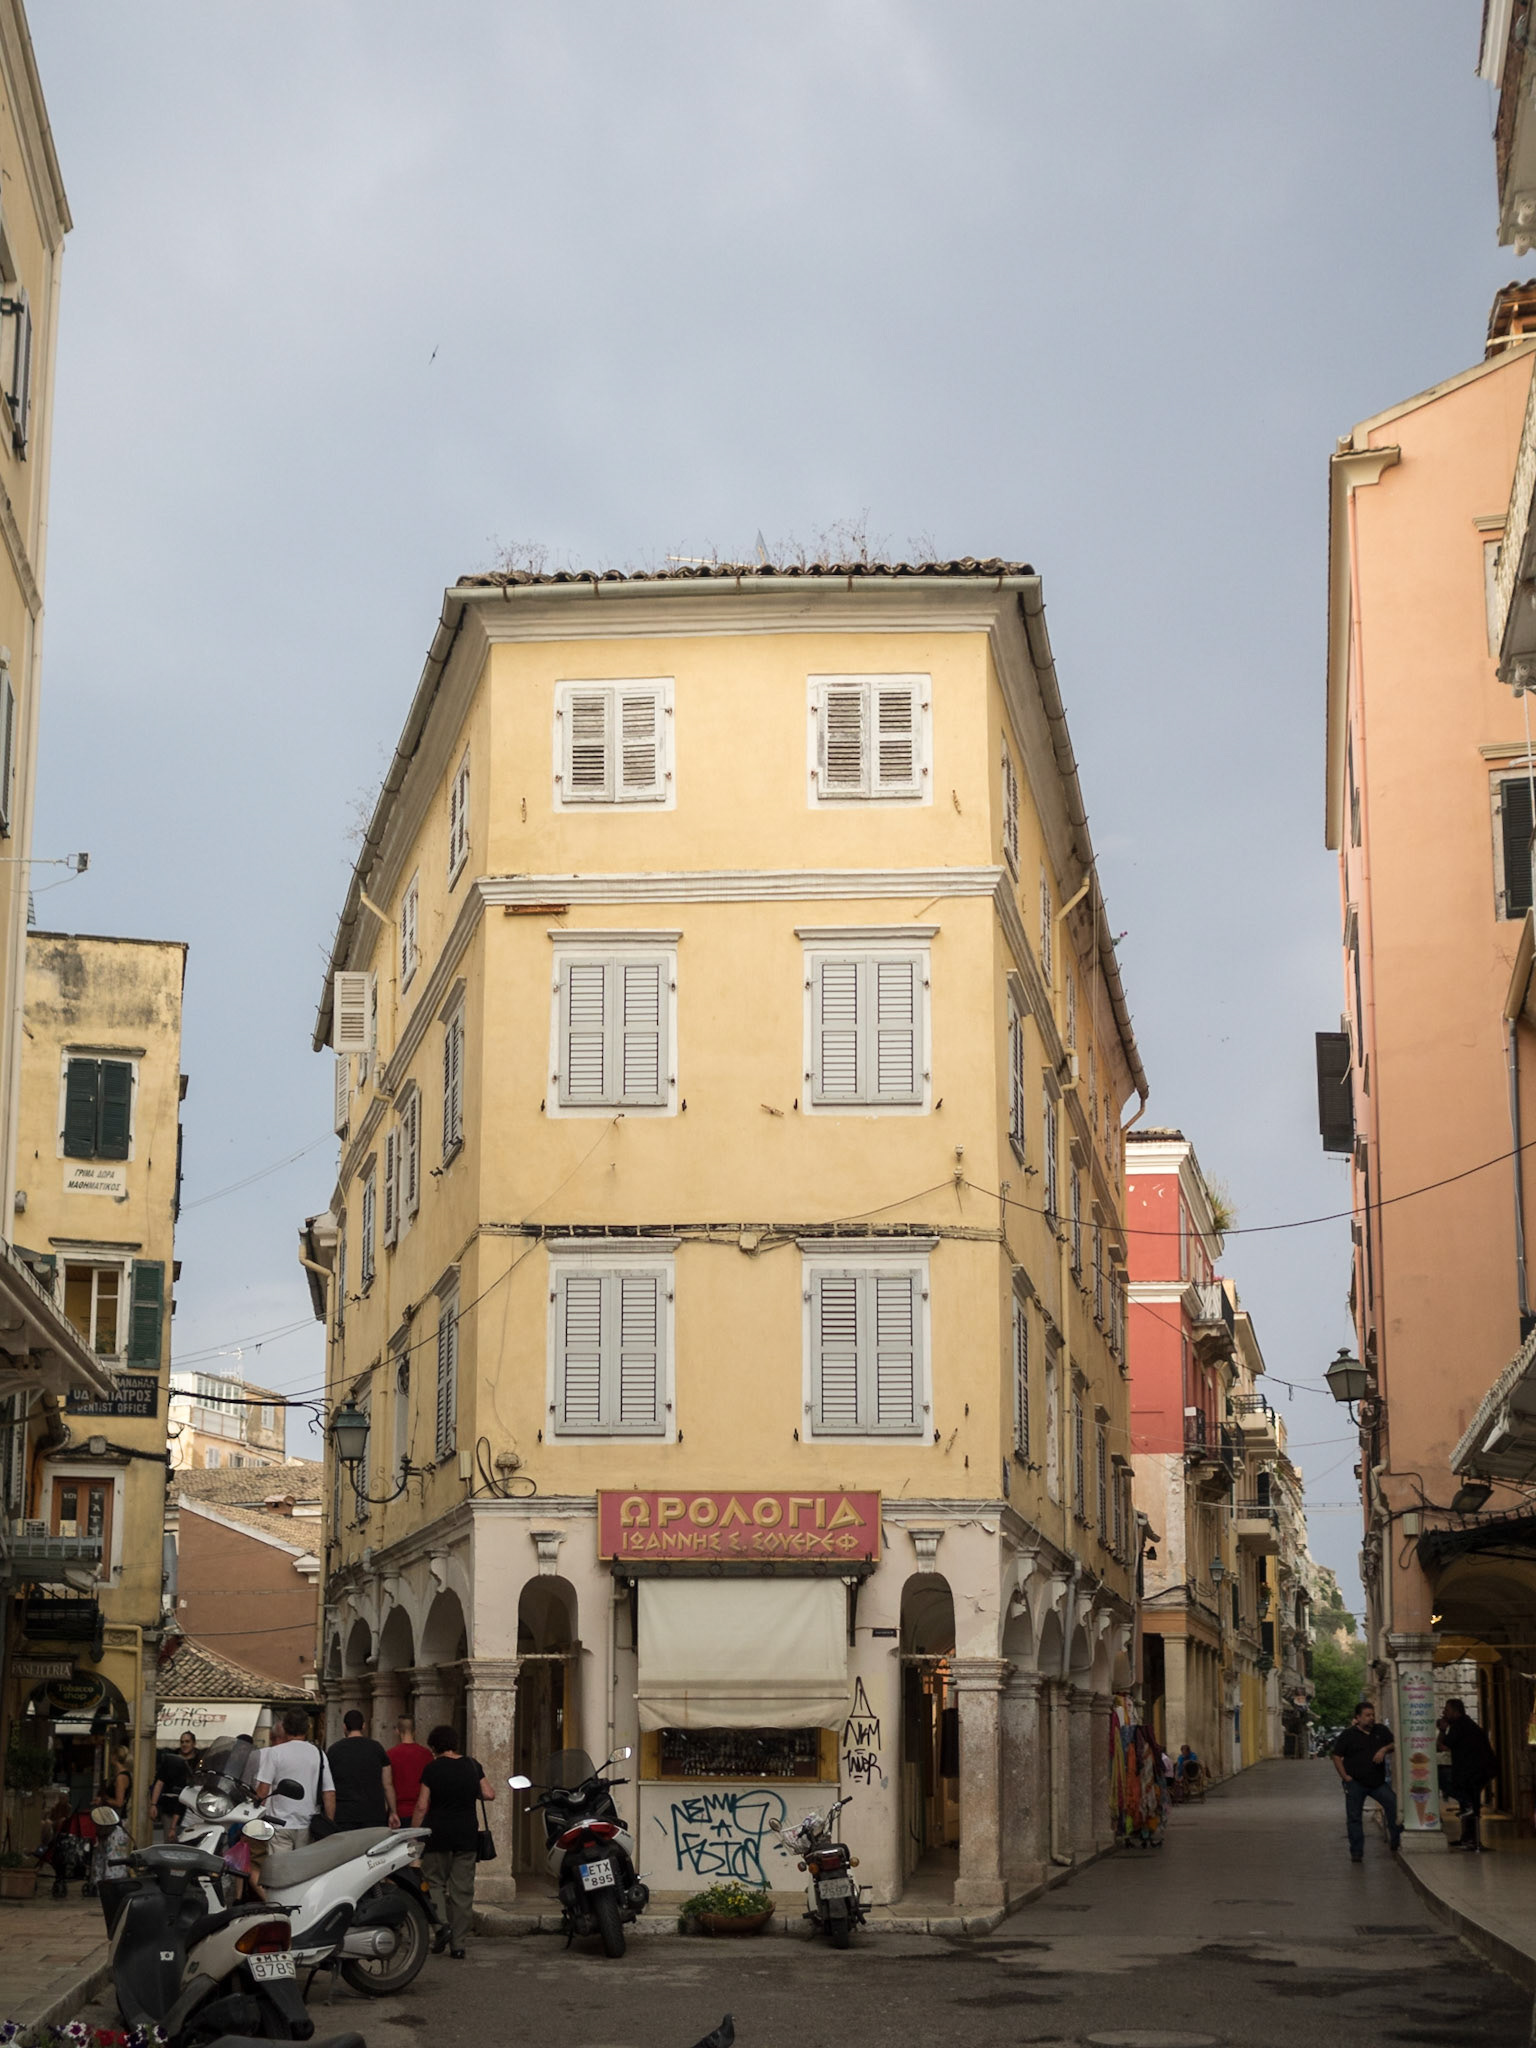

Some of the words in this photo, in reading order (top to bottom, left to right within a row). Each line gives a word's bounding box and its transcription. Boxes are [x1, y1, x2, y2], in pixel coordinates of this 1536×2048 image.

[67, 1180, 121, 1191] ΜΑΘΗΜΑΤΙΚΟΣ
[73, 1388, 151, 1402] ΟΔΤΙΑΤΡΟΣ
[117, 1403, 148, 1414] OFFICE
[620, 1496, 866, 1530] ΩΡΟΛΟΓΙΑ
[623, 1531, 724, 1551] ΙΩΑΝΝΗΣ
[752, 1531, 859, 1551] ΣΟΥΕΡΕΦ
[56, 1683, 94, 1693] Tobacco
[64, 1692, 87, 1701] shop
[588, 1862, 610, 1875] ETX
[591, 1875, 613, 1887] 895
